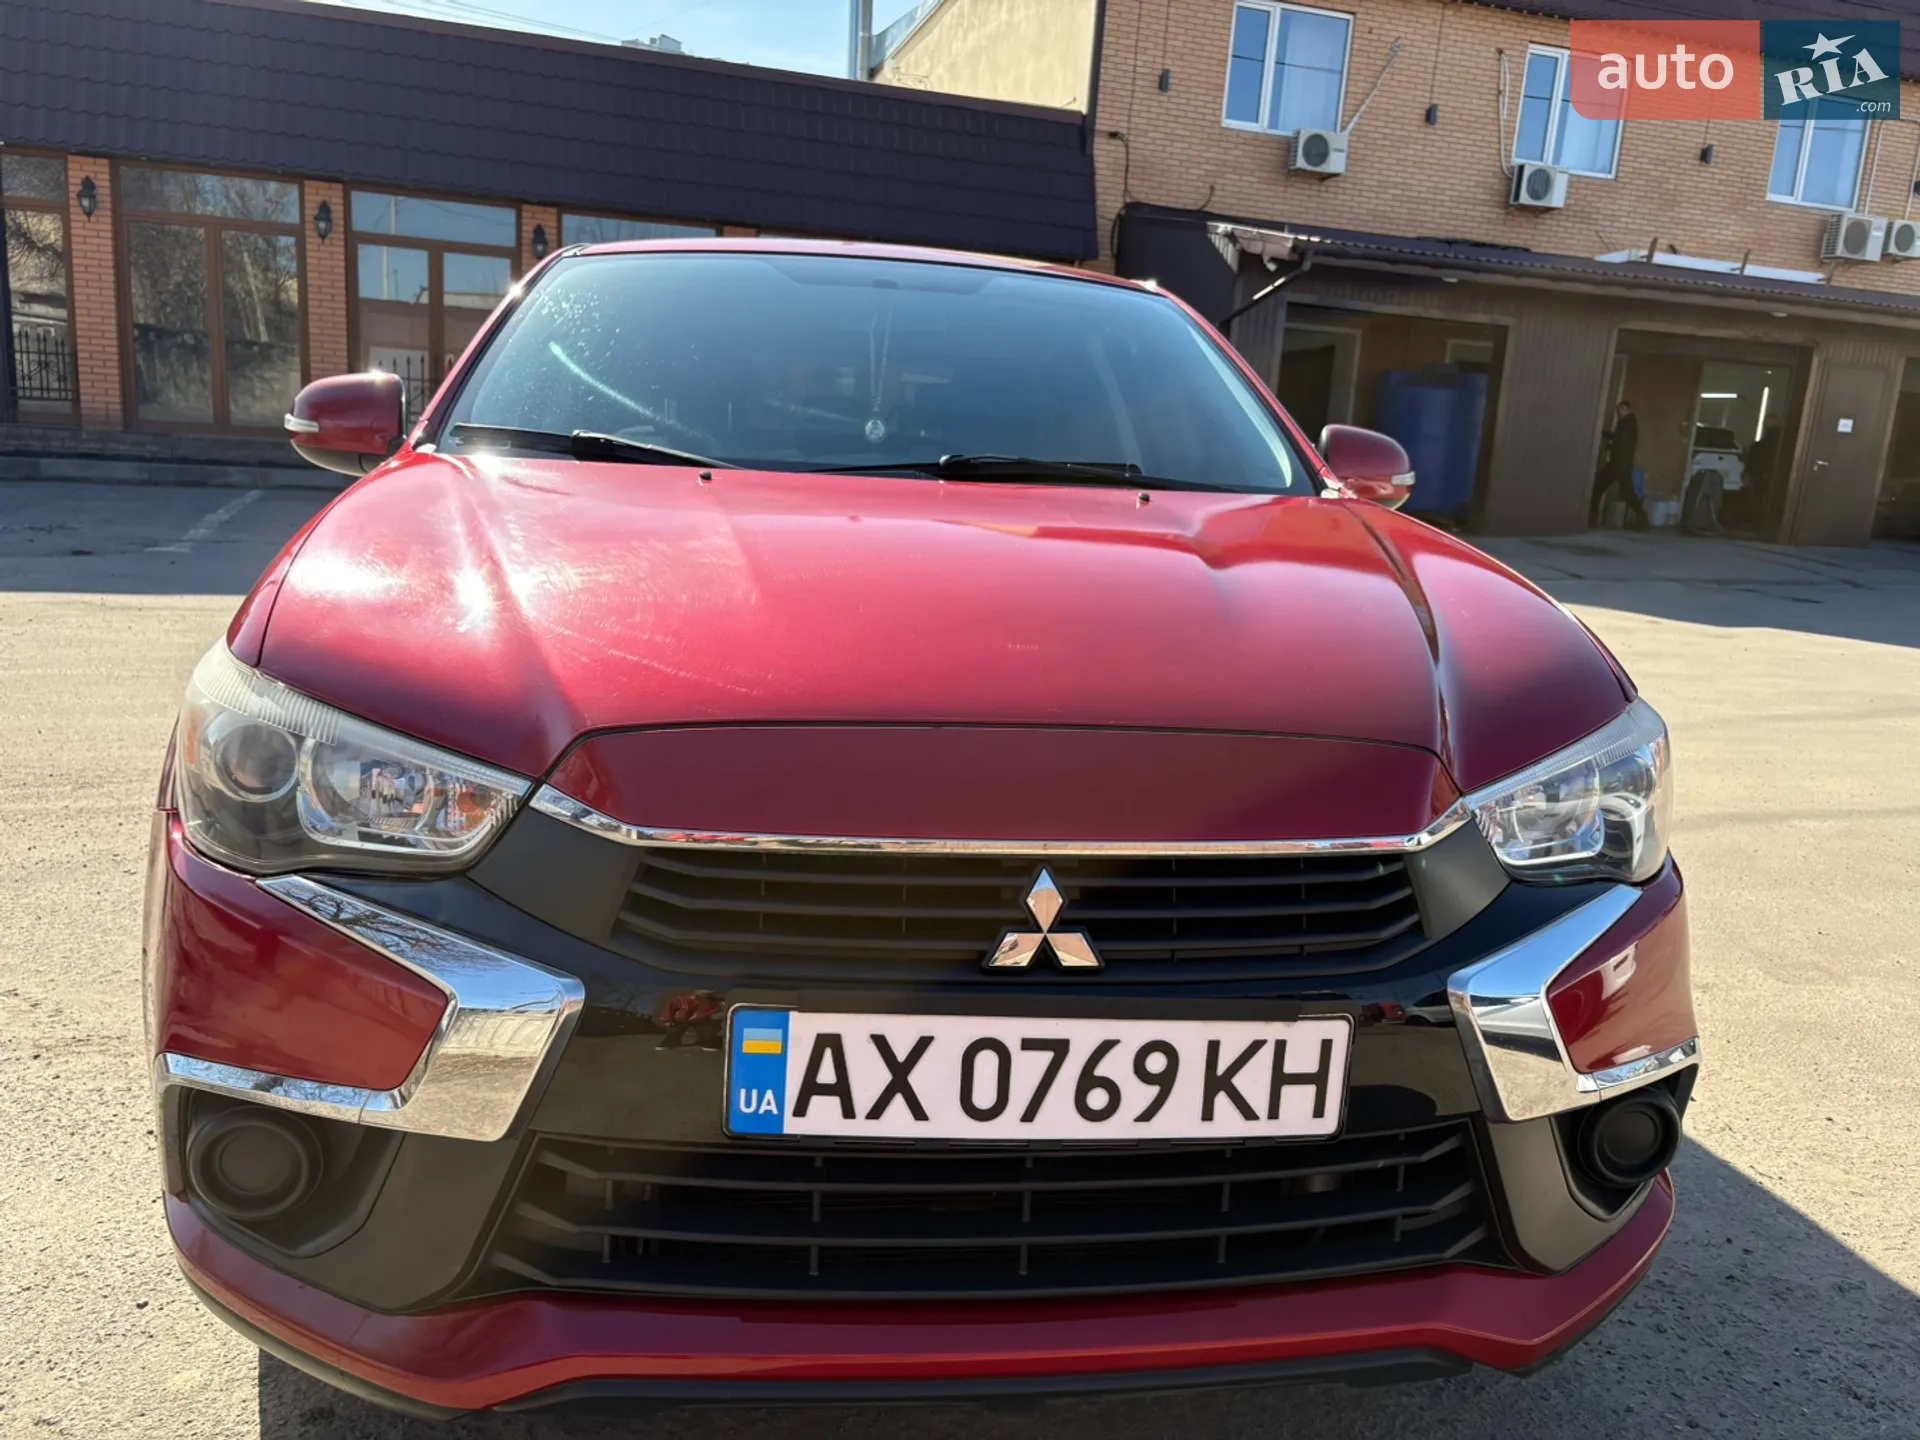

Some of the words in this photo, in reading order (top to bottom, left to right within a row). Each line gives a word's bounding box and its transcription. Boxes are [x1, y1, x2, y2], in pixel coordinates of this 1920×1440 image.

[739, 1088, 779, 1115] UA
[792, 1033, 935, 1121] AX
[960, 1036, 1180, 1123] 0769
[1200, 1038, 1334, 1122] KH
